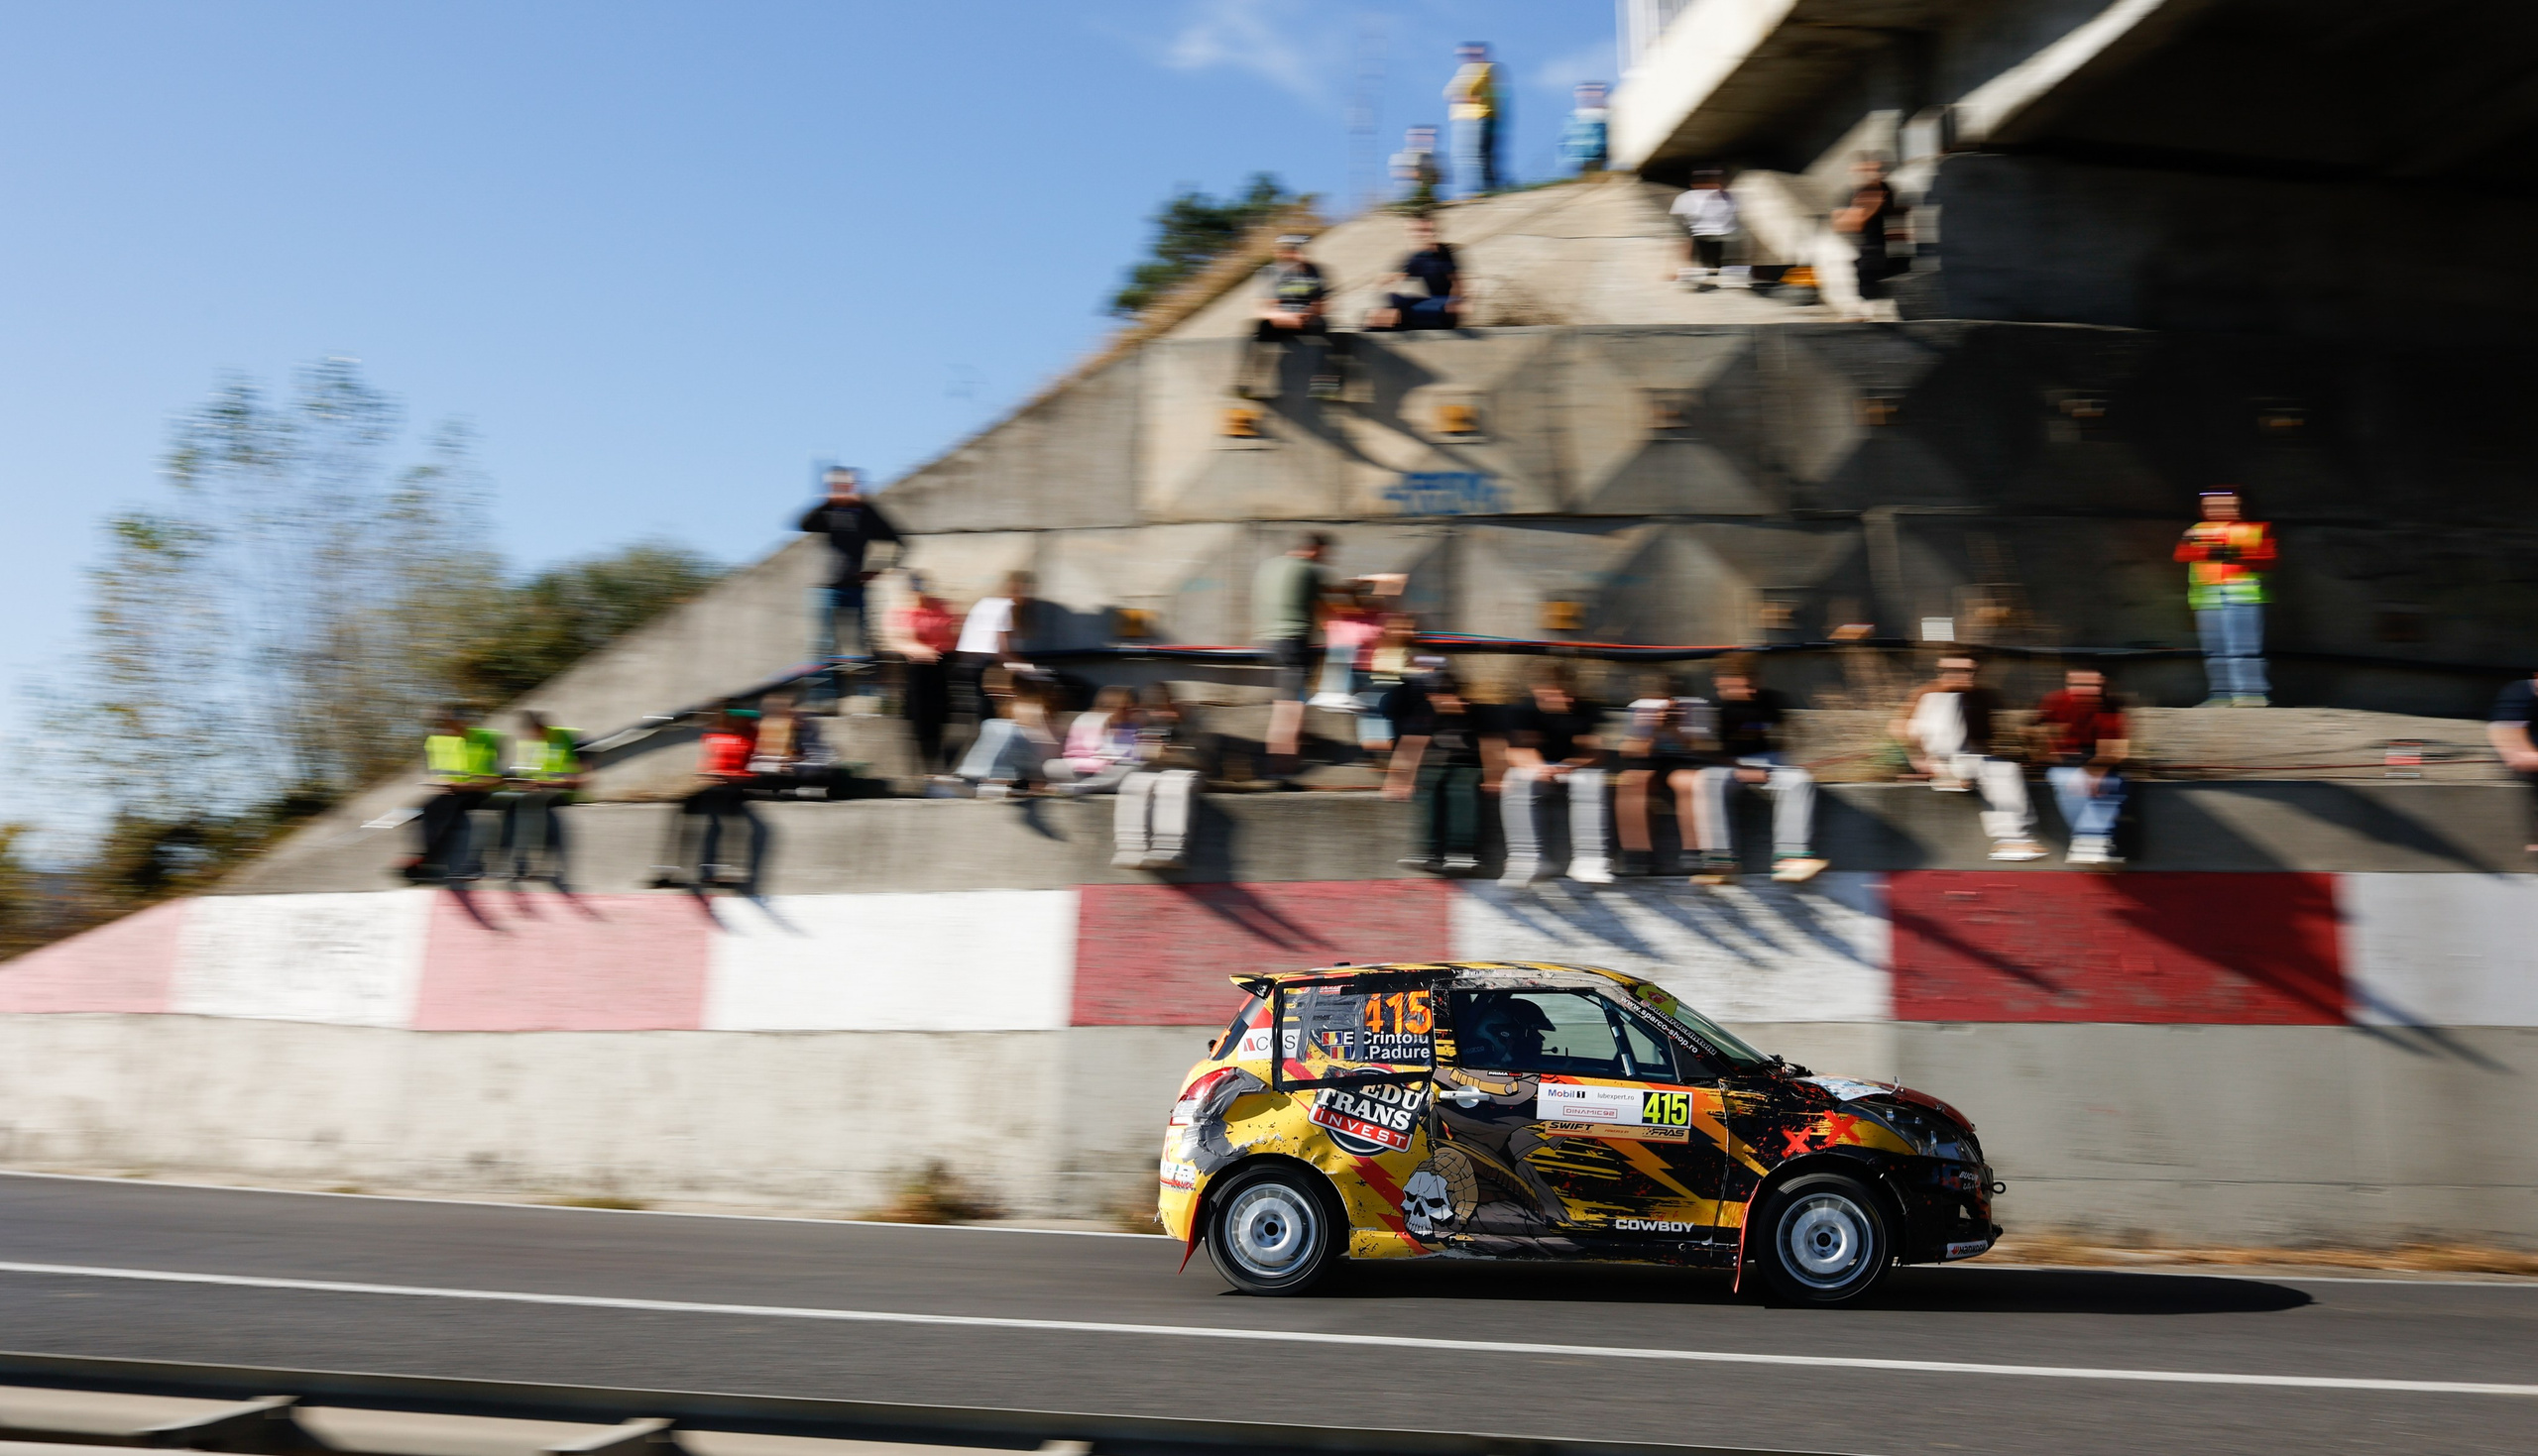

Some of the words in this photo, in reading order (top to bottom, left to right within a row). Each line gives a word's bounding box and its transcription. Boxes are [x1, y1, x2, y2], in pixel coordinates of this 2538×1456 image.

[1364, 990, 1433, 1034] 415
[1548, 1089, 1574, 1098] Mobil
[1597, 1092, 1635, 1101] lubexpert.ro
[1317, 1087, 1412, 1131] TRANS
[1643, 1092, 1687, 1126] 415
[1549, 1122, 1594, 1131] SWIFT
[1615, 1219, 1694, 1233] COWBOY
